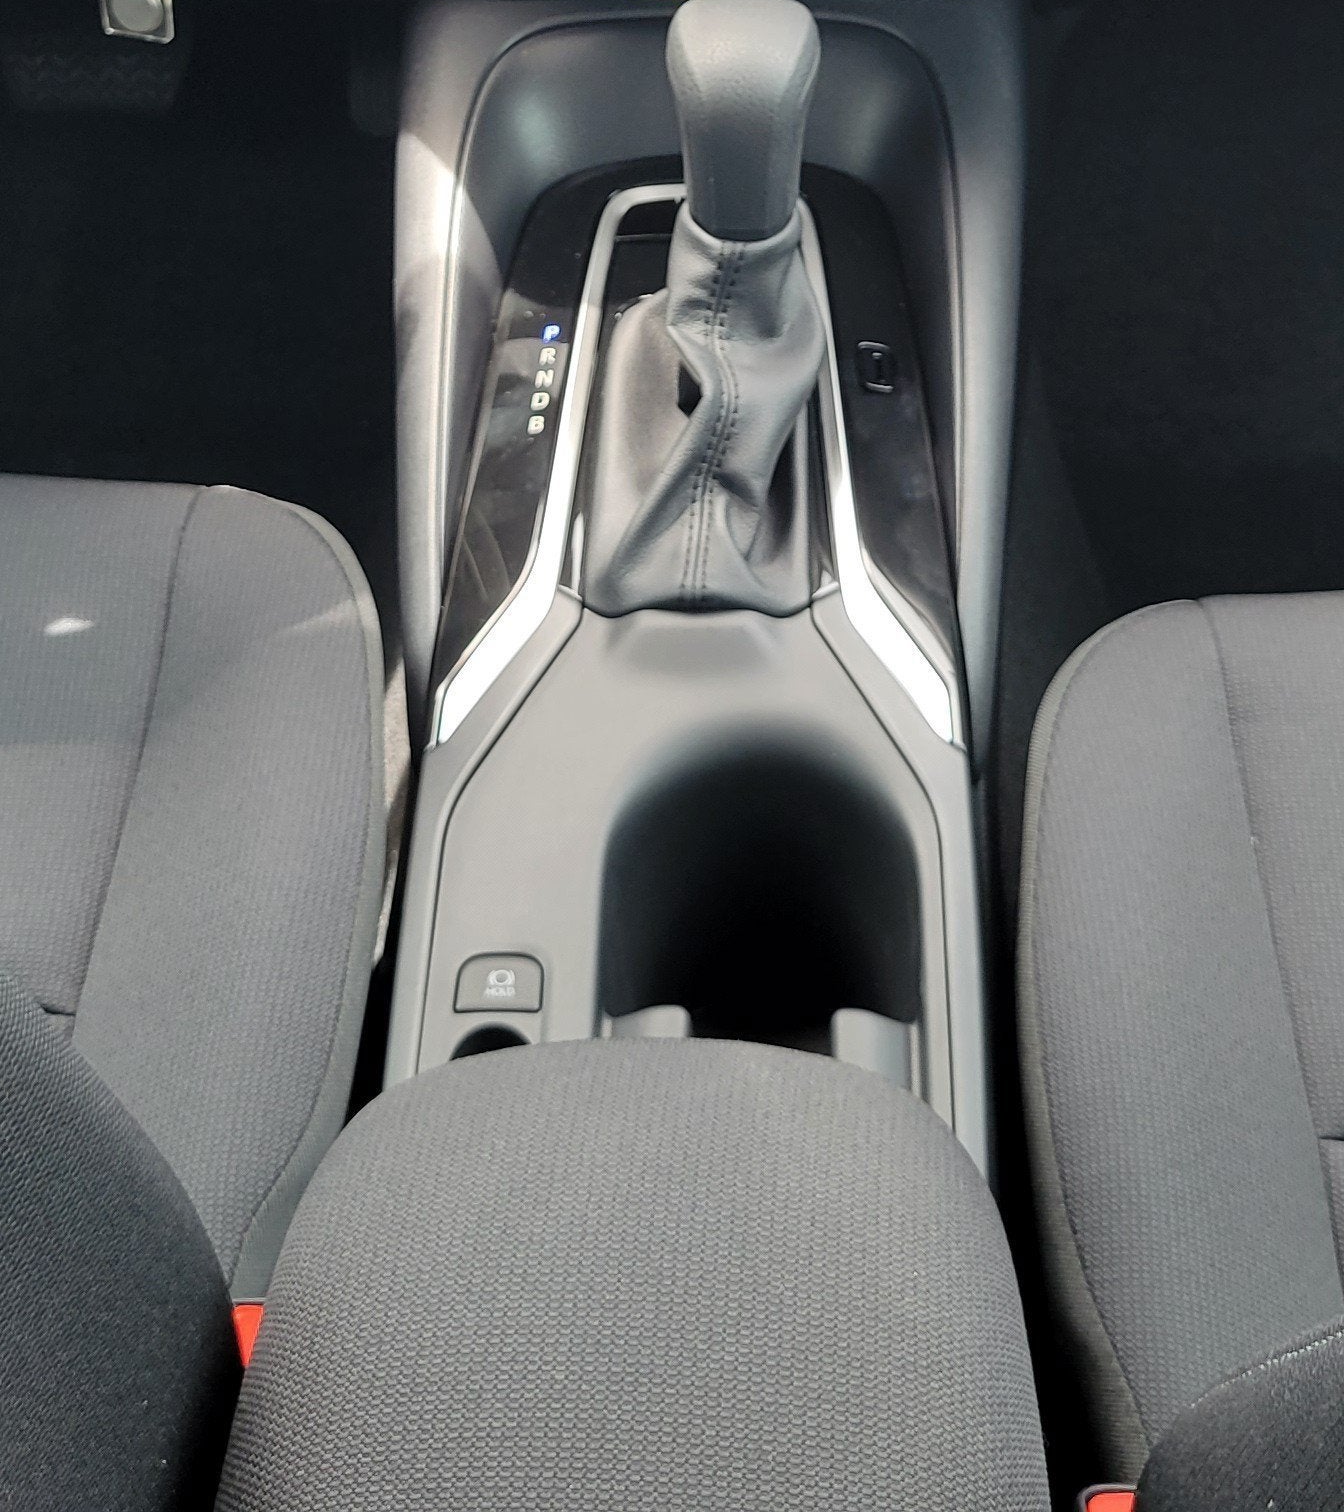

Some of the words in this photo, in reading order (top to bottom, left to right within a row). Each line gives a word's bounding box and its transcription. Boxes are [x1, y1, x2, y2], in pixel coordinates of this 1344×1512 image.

[542, 325, 562, 343] P
[539, 347, 556, 366] R
[535, 369, 555, 389] N
[530, 391, 551, 411] D
[527, 415, 545, 435] B
